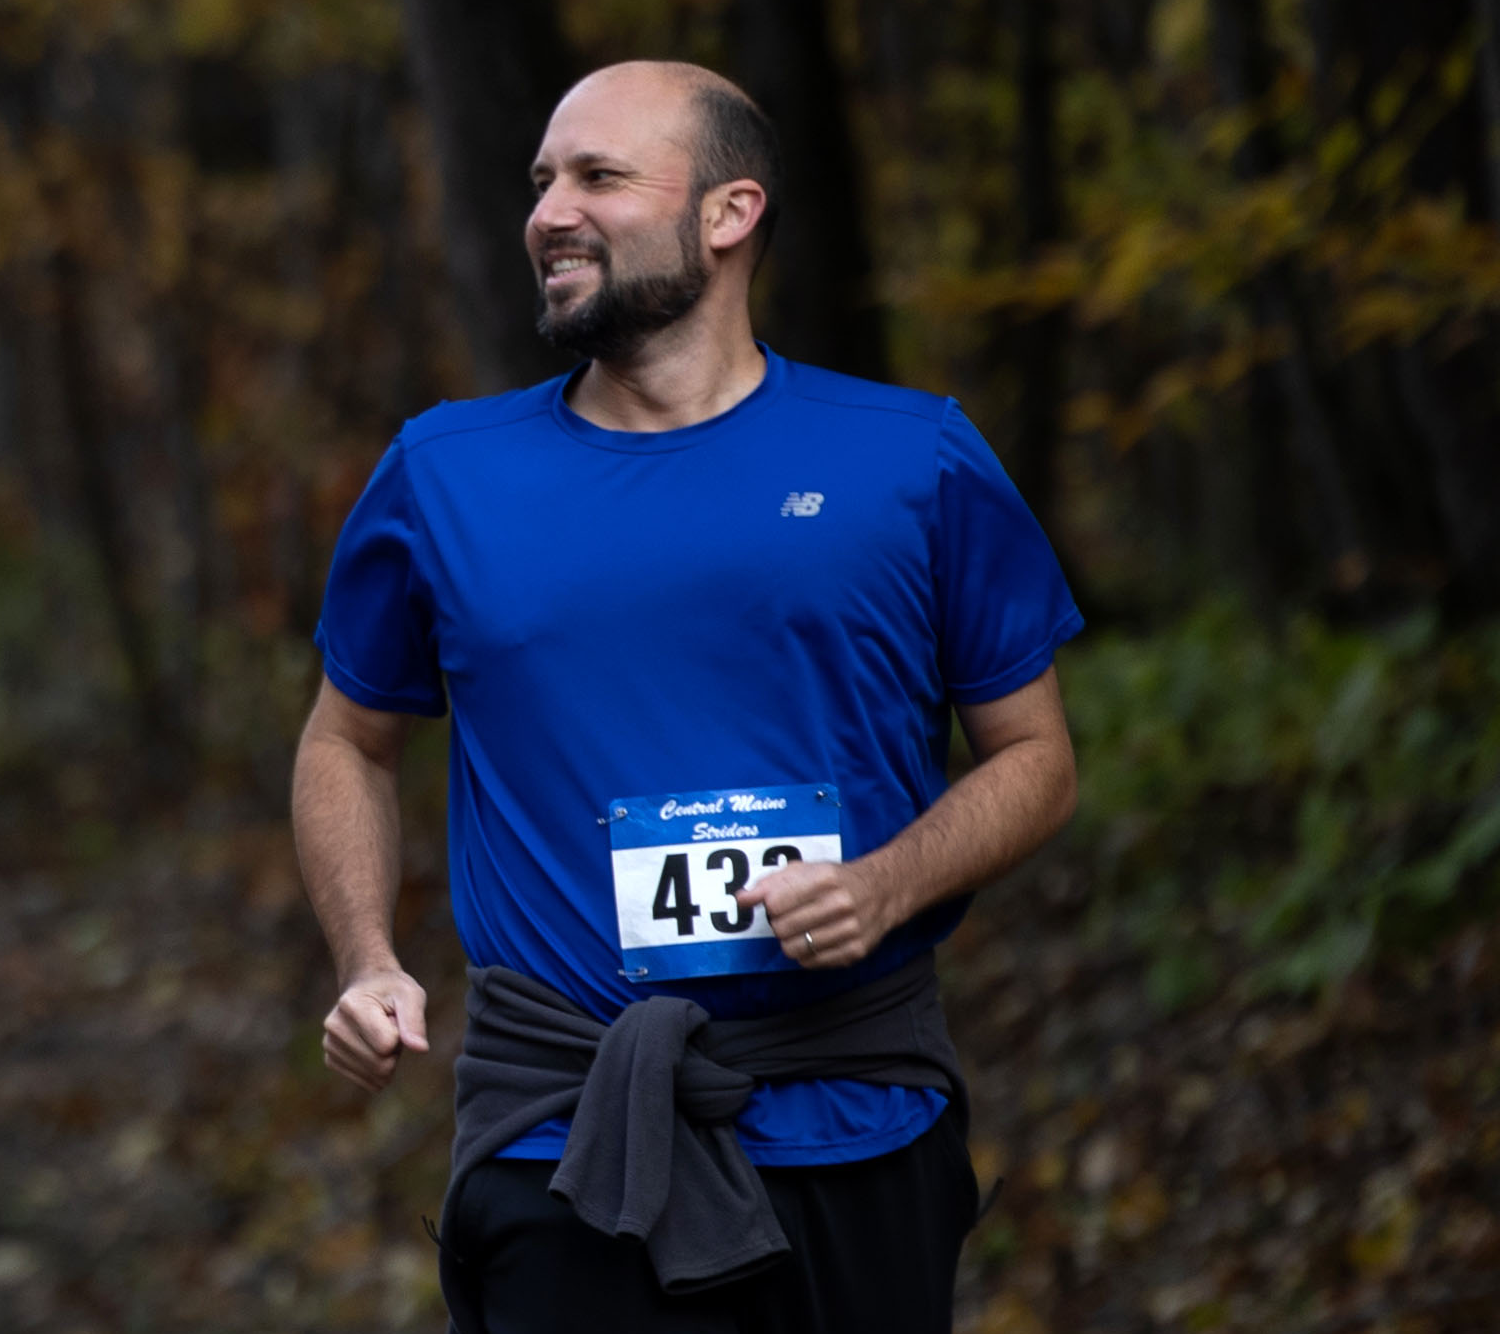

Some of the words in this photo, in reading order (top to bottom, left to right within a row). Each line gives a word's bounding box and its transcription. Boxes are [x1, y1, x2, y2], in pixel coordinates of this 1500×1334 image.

[659, 798, 724, 820] Central
[729, 795, 787, 813] Maine
[691, 822, 760, 841] Striders
[652, 845, 803, 936] 43
